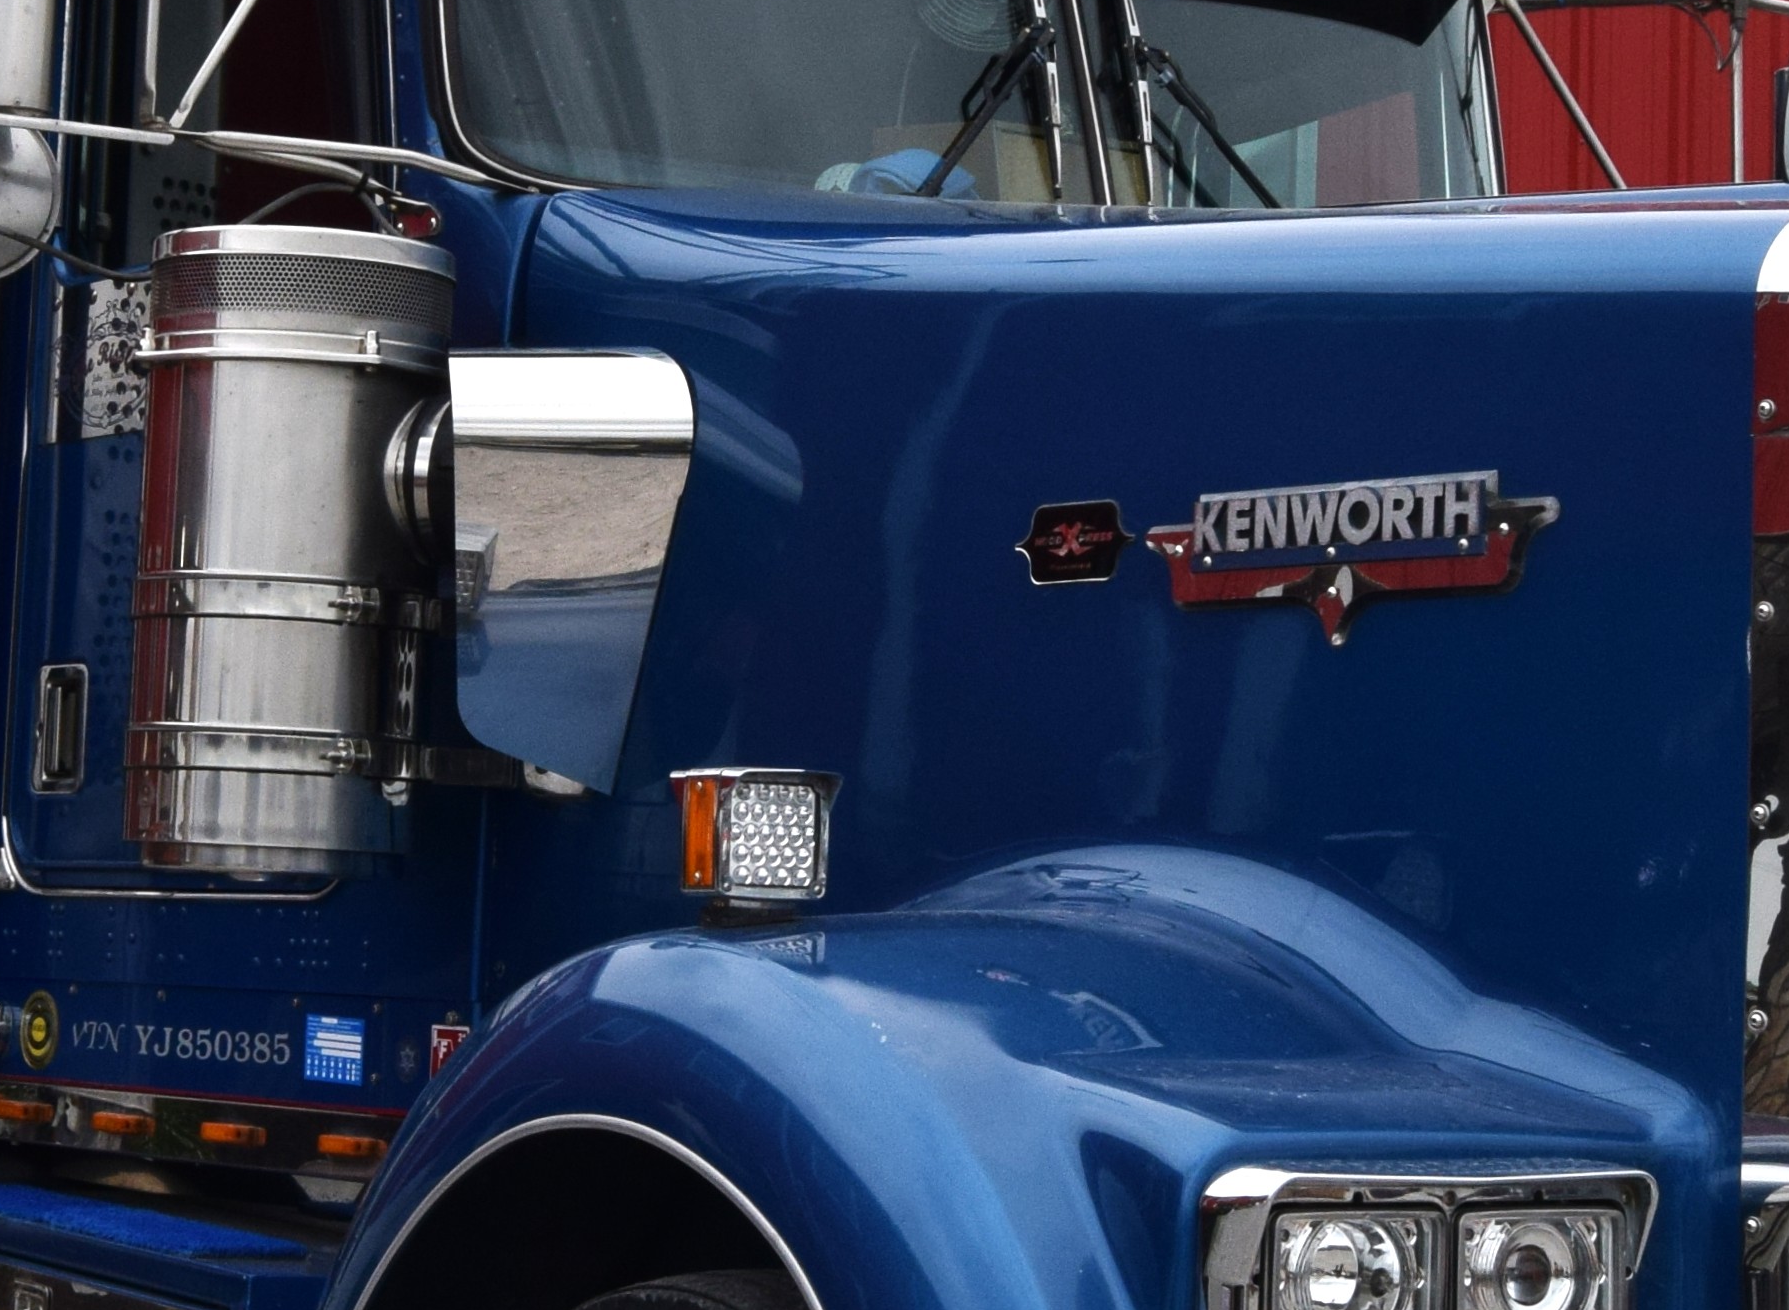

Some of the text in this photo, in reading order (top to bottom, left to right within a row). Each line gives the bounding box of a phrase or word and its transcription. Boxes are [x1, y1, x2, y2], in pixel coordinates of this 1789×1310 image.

[1193, 480, 1482, 554] KENWORTH
[72, 1020, 126, 1053] VIN
[134, 1024, 291, 1065] YJ850385
